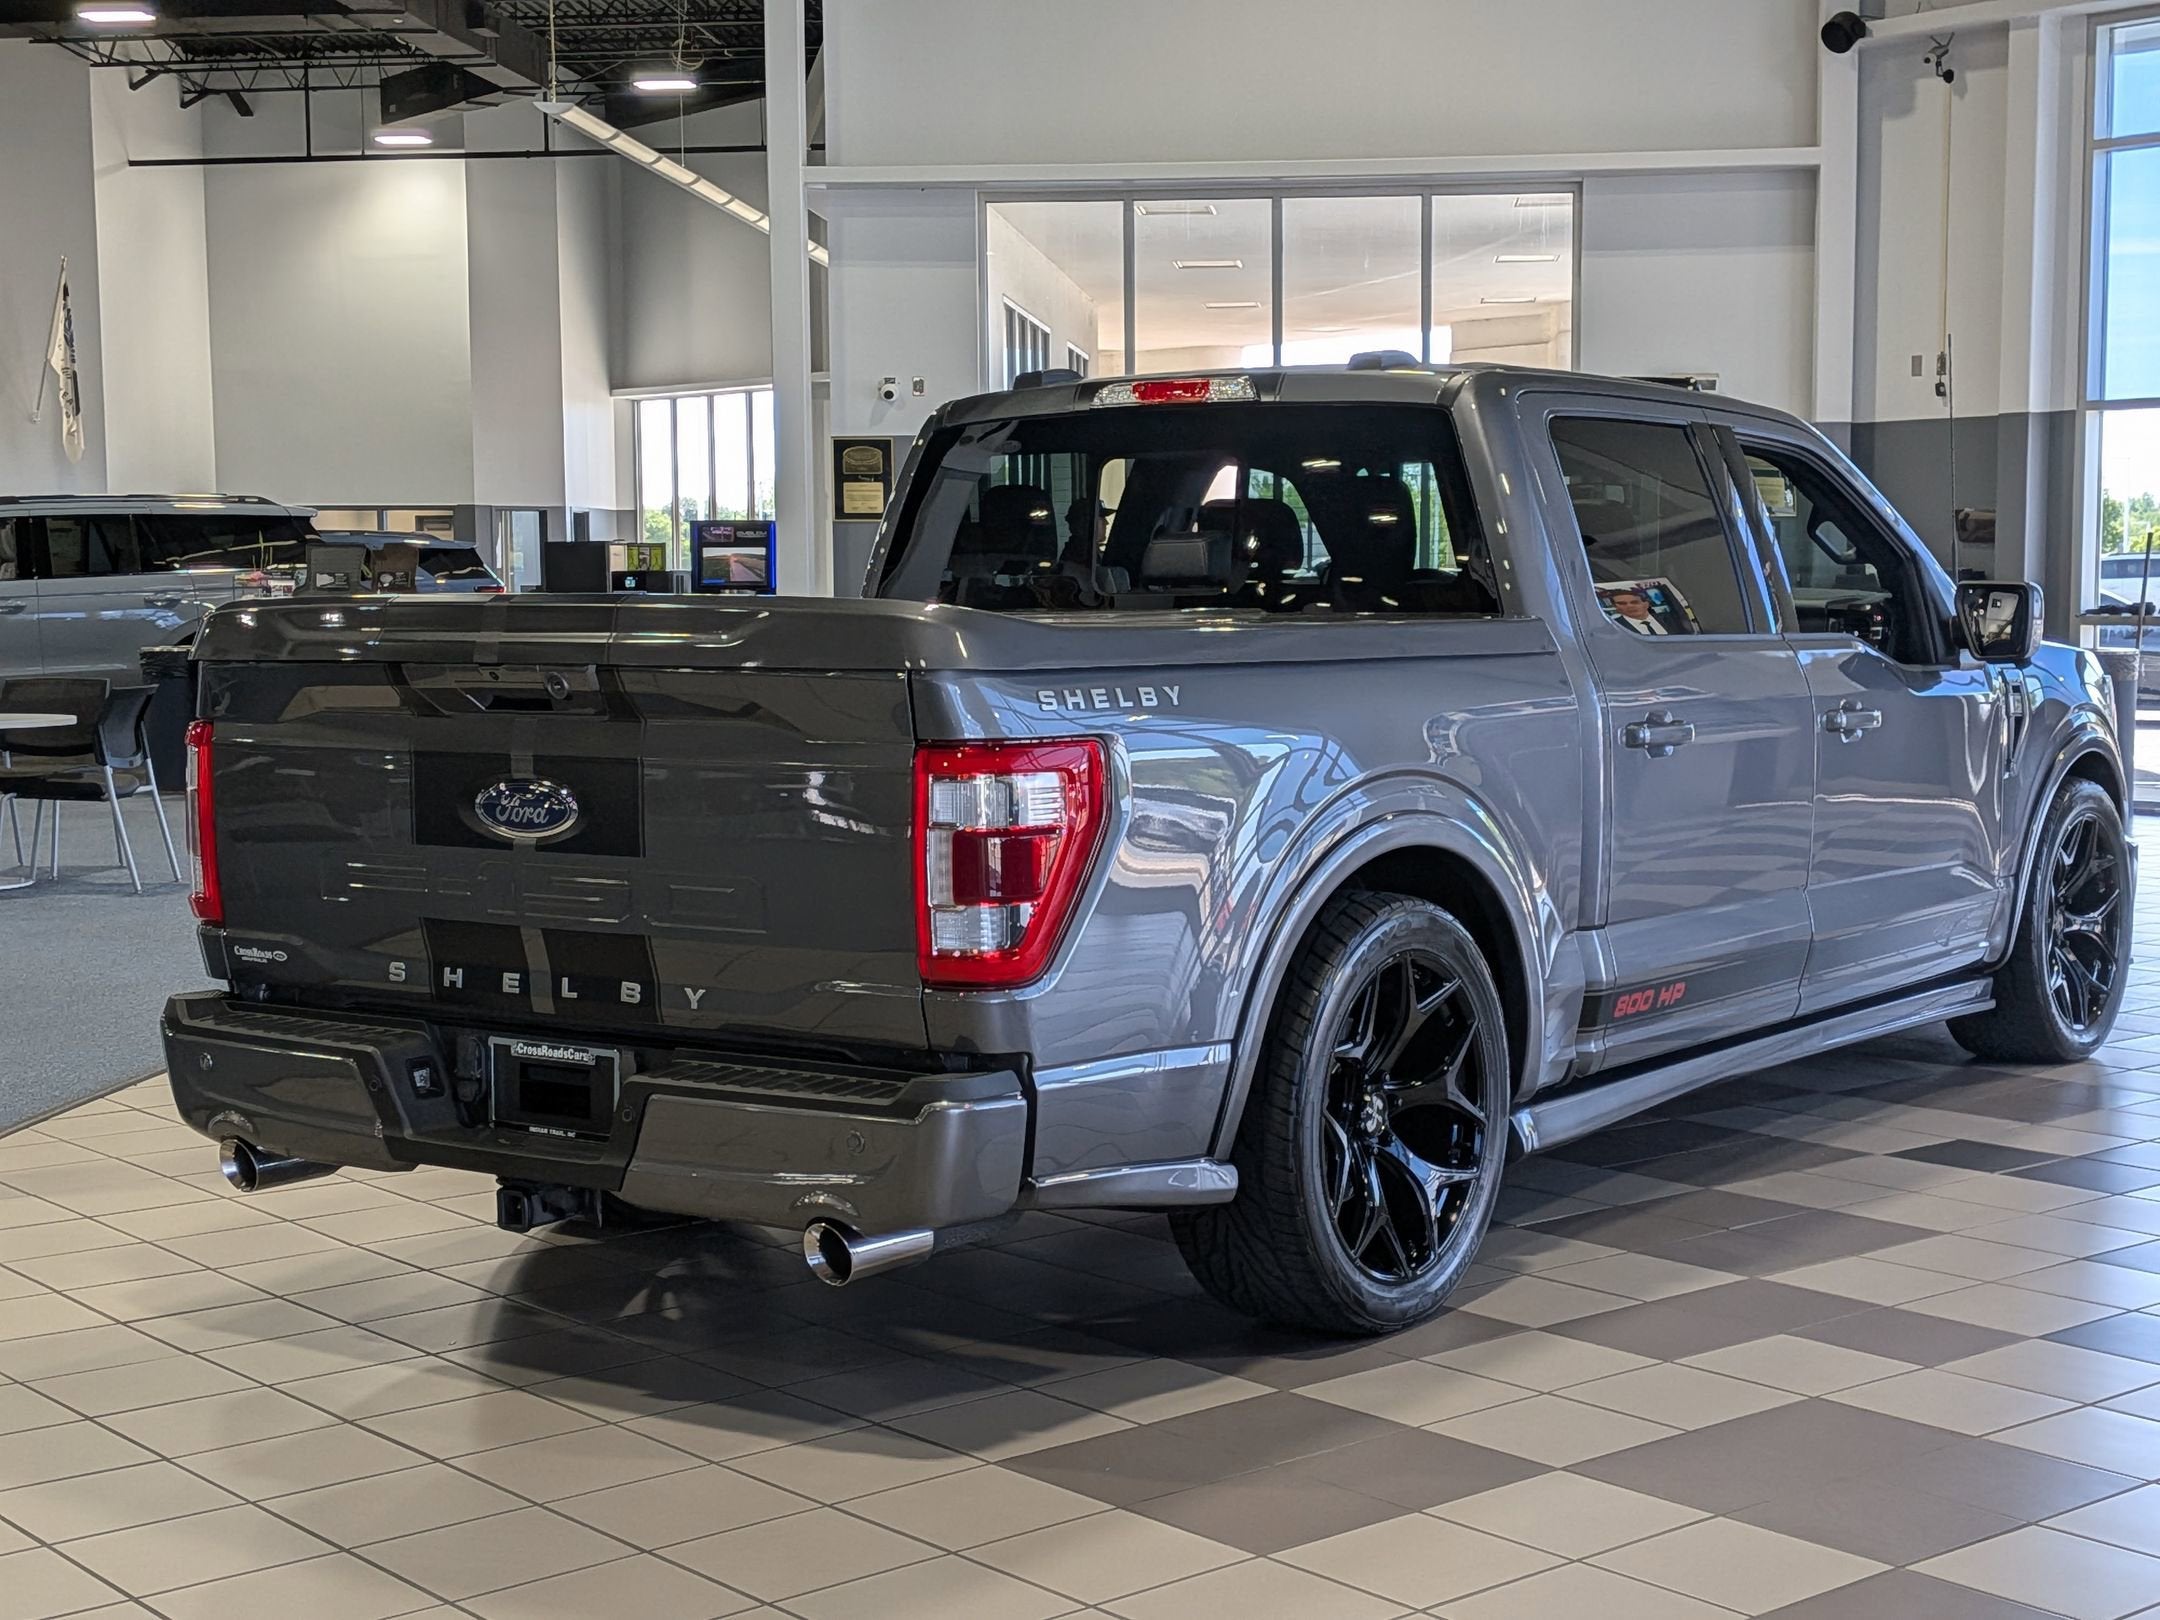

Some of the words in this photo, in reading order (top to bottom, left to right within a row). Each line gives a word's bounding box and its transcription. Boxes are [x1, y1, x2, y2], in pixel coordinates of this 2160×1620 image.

[1037, 684, 1181, 713] SHELBY
[495, 793, 550, 824] Ford
[388, 951, 706, 1011] SHELBY
[1613, 988, 1655, 1018] 800
[1656, 981, 1686, 1008] HP
